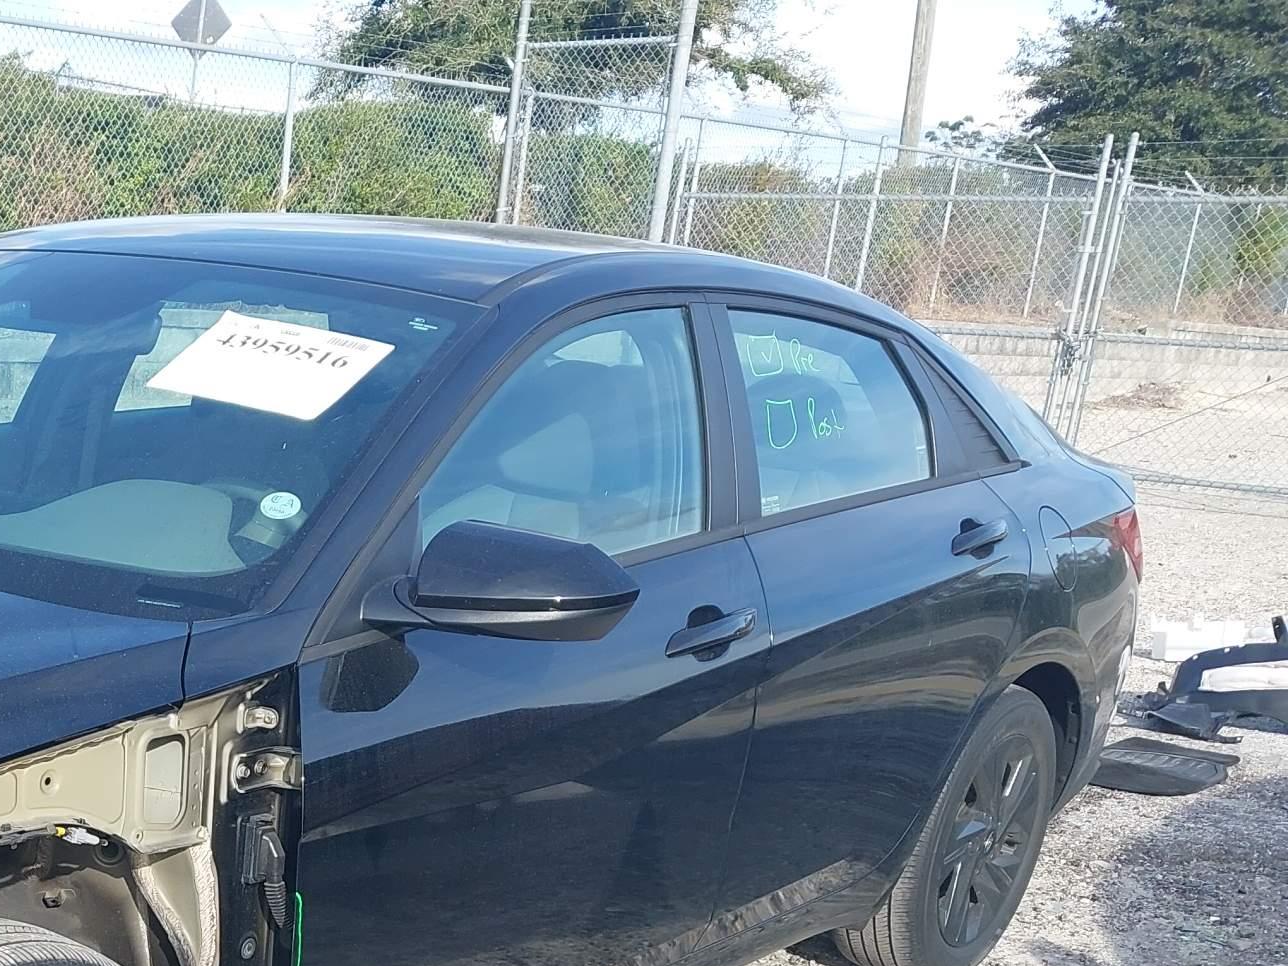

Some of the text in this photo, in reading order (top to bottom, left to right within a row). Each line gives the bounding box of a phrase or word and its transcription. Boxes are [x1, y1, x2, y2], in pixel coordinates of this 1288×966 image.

[216, 333, 349, 369] 43959516
[789, 338, 822, 375] Pre
[807, 397, 845, 439] Post
